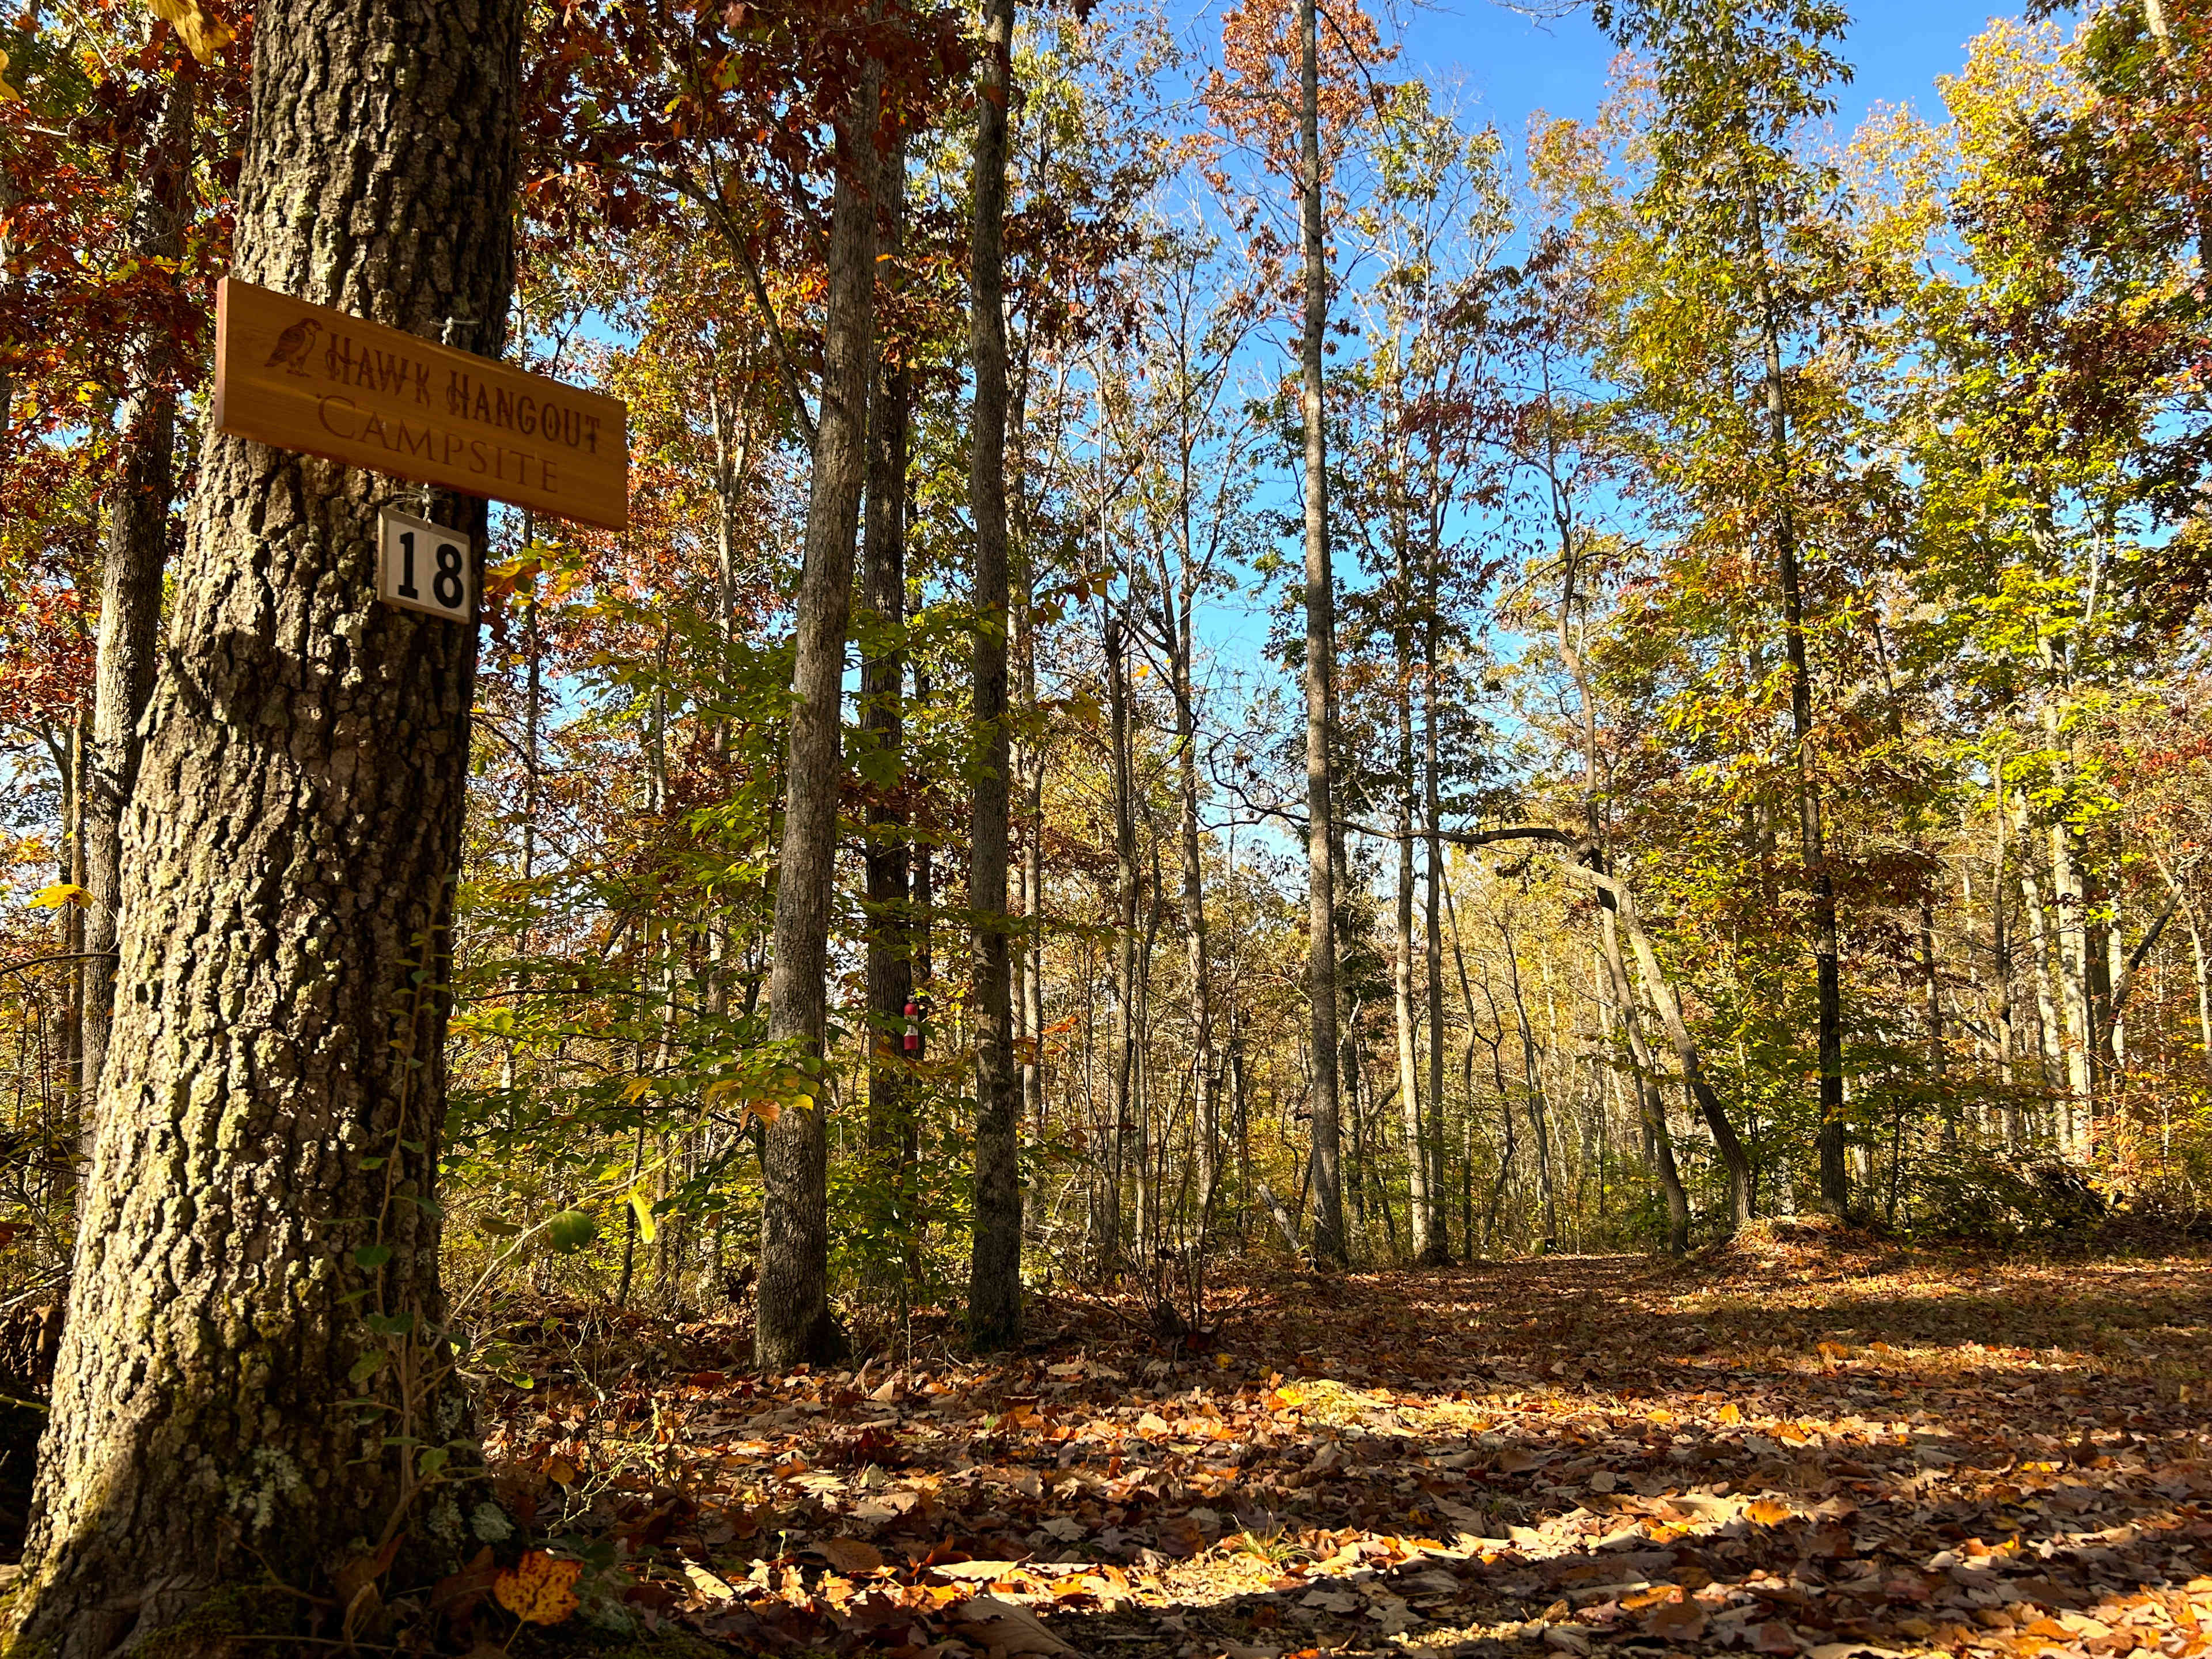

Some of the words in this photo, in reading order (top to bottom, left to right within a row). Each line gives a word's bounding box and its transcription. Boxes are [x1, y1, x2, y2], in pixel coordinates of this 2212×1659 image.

[326, 332, 430, 407] HAWK
[446, 369, 600, 453] HANGOUT
[318, 394, 559, 493] CAMPSITE
[397, 532, 463, 609] 18
